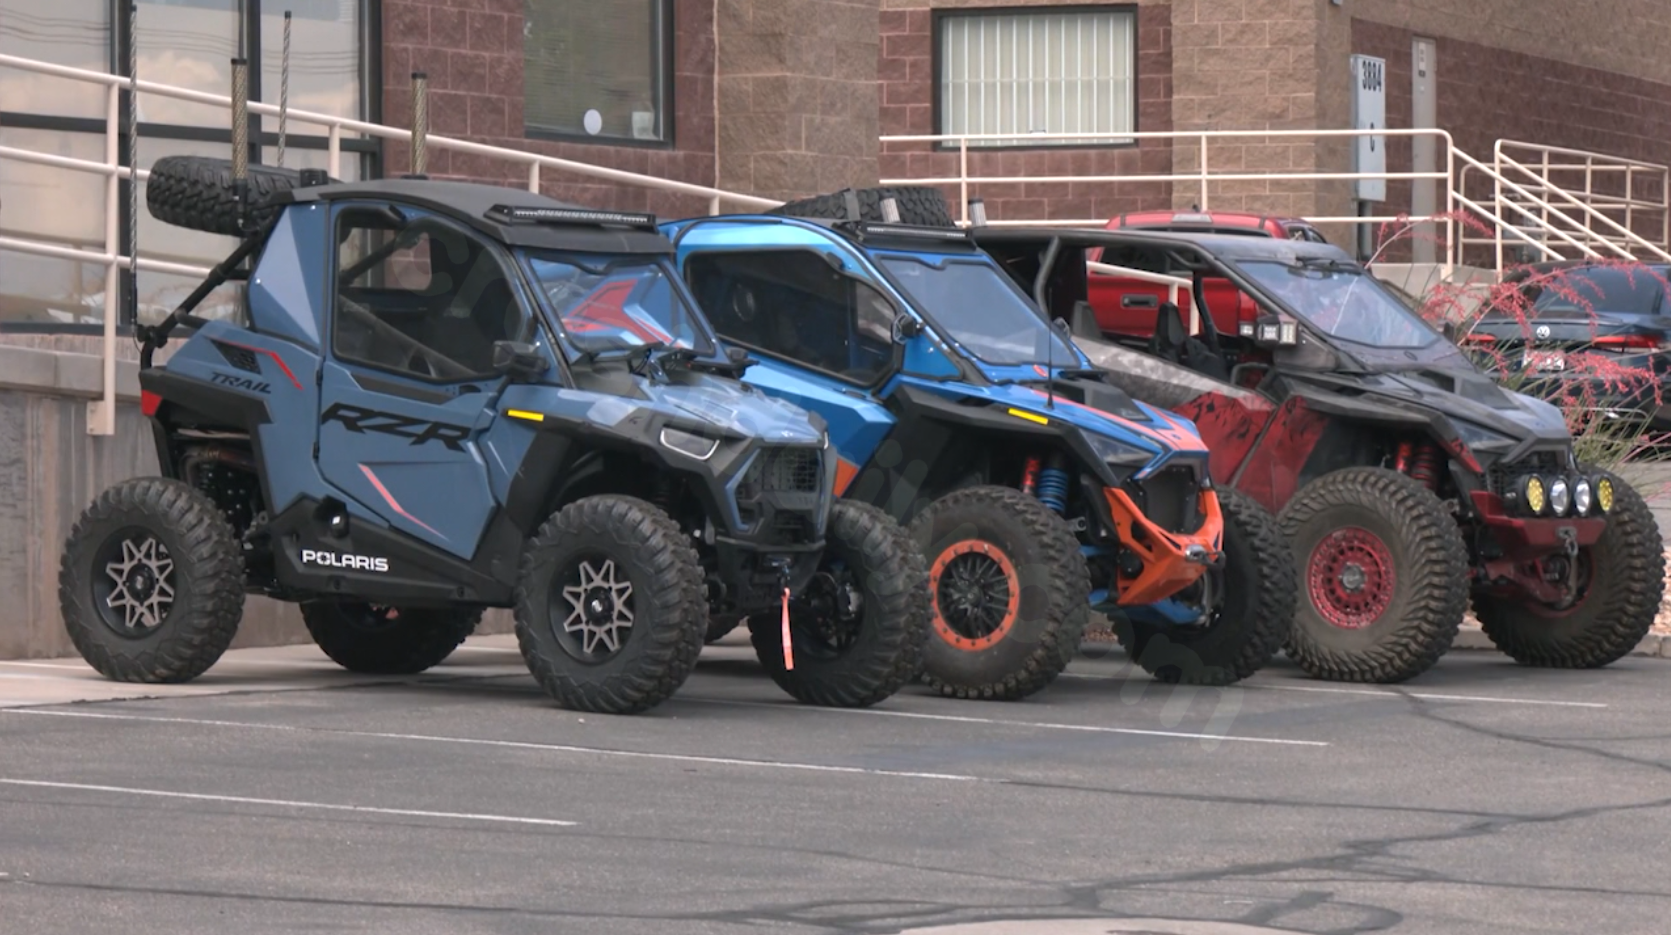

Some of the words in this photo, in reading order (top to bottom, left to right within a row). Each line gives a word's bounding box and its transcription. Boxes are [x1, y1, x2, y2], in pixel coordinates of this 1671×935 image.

[1362, 60, 1382, 92] 3884
[211, 371, 272, 394] TRAIL
[321, 402, 472, 453] RZR
[302, 549, 389, 572] POLARIS
